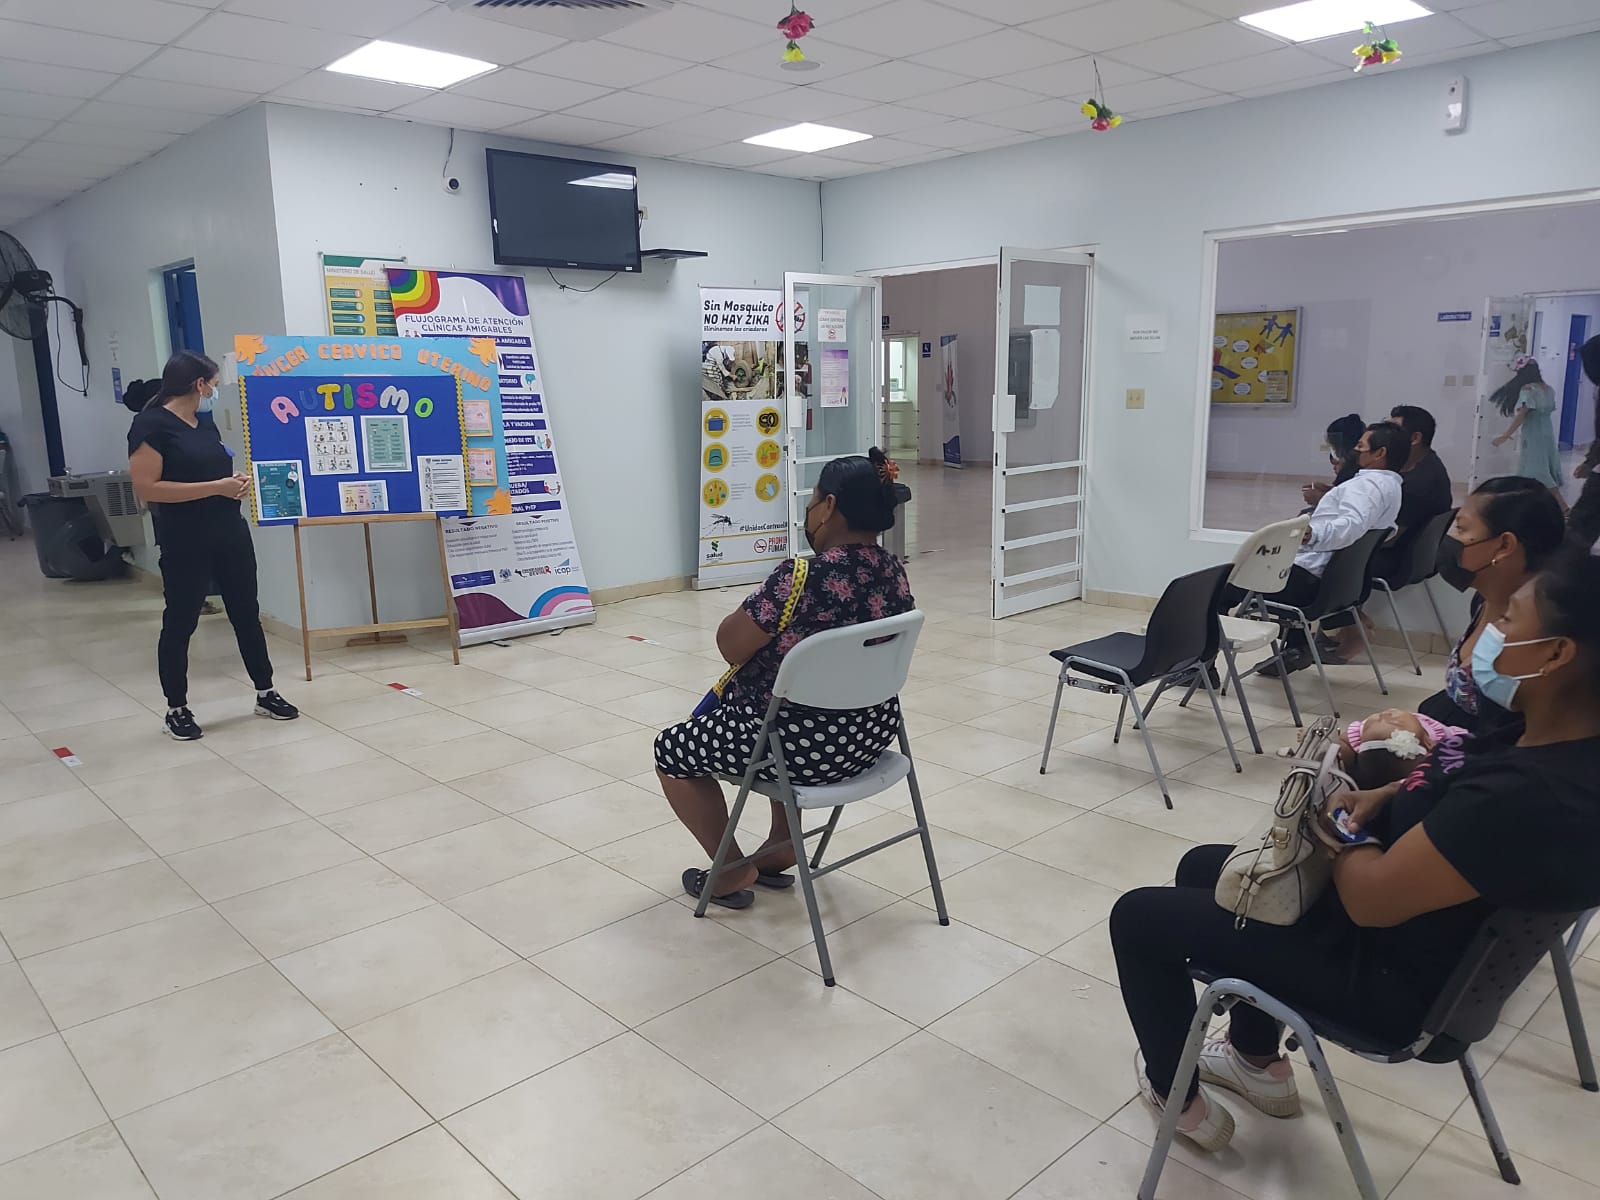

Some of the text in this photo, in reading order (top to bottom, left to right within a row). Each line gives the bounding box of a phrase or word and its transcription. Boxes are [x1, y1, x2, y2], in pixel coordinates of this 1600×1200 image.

[703, 300, 774, 316] Sin Mosquito
[404, 315, 466, 323] FLUJOGRAMA
[482, 317, 524, 326] ATENCIÓN
[703, 314, 770, 325] NO HAY ZIKA
[421, 323, 513, 334] CLÍNICAS AMIGABLES
[318, 343, 402, 360] CERVICO
[417, 349, 492, 392] UTERINO
[270, 383, 434, 424] AUTISMO
